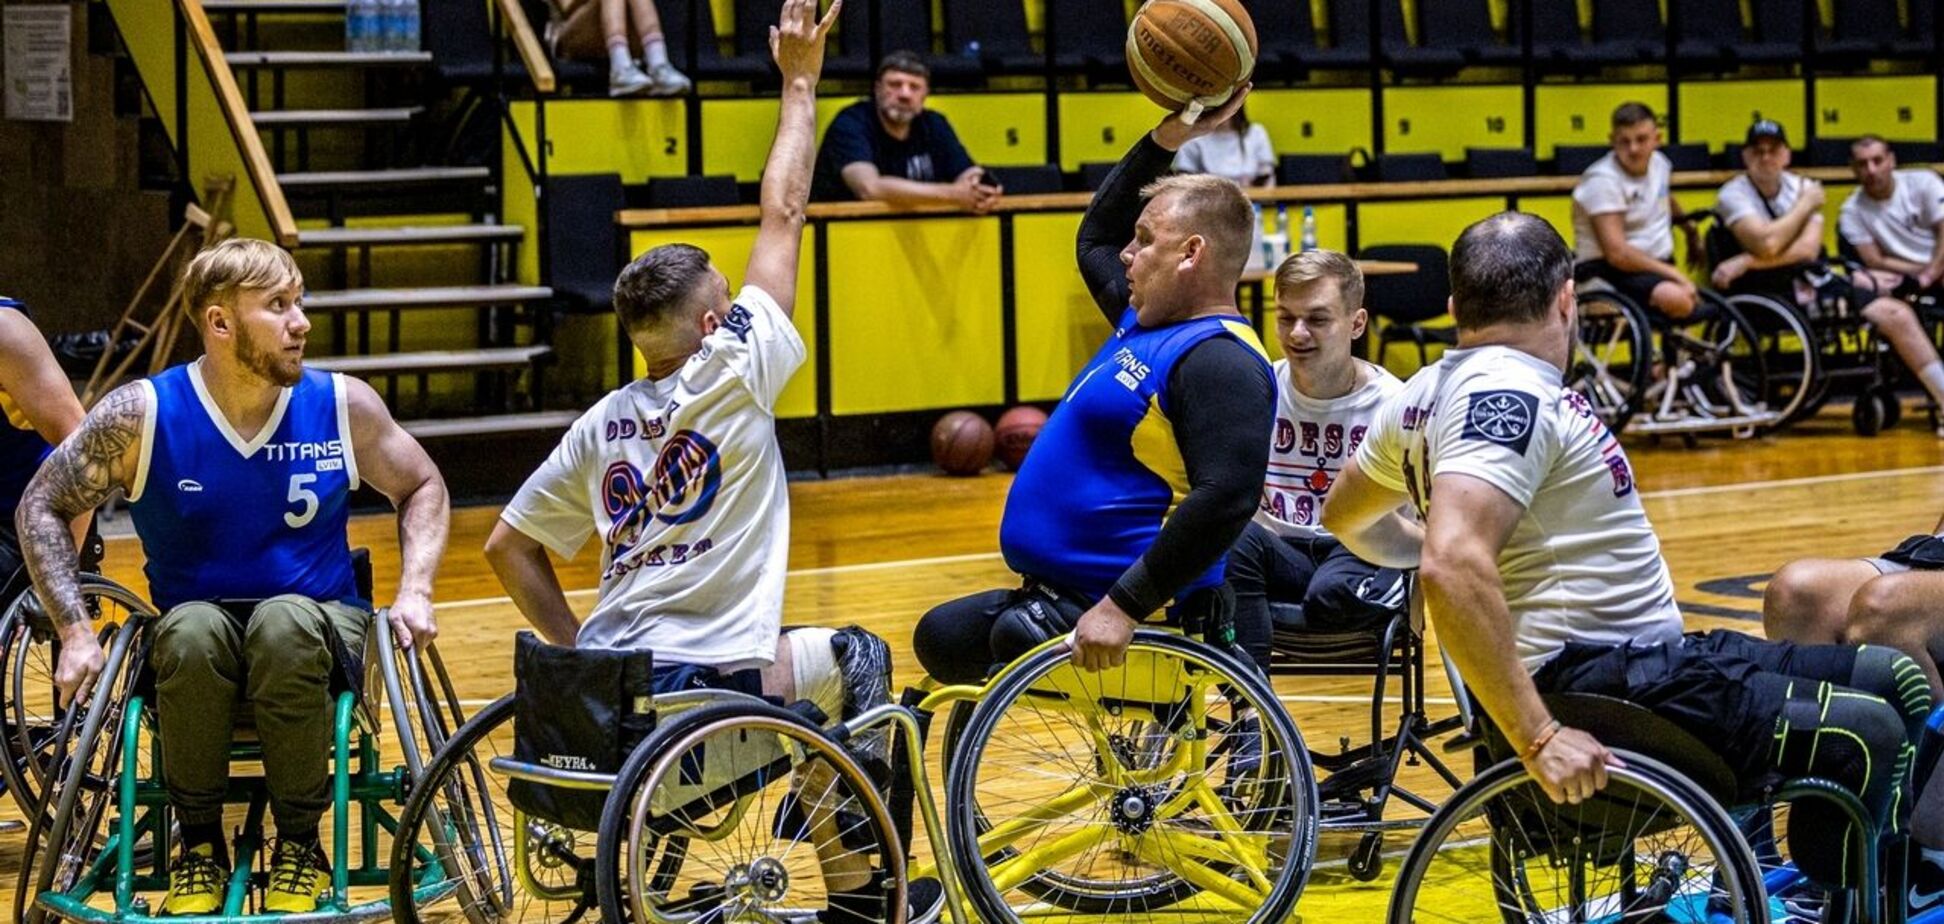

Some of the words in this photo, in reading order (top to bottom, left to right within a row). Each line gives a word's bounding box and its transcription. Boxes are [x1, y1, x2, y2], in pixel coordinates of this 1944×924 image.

[1140, 28, 1215, 90] meteor
[1823, 109, 1839, 124] 14
[1897, 106, 1912, 123] 15
[1301, 121, 1313, 137] 8
[1398, 118, 1410, 135] 9
[1486, 116, 1505, 133] 10
[1006, 128, 1018, 146] 5
[1102, 127, 1115, 144] 6
[664, 138, 677, 155] 2
[1275, 417, 1368, 459] DESS
[264, 440, 343, 461] TITANS
[284, 473, 319, 528] 5
